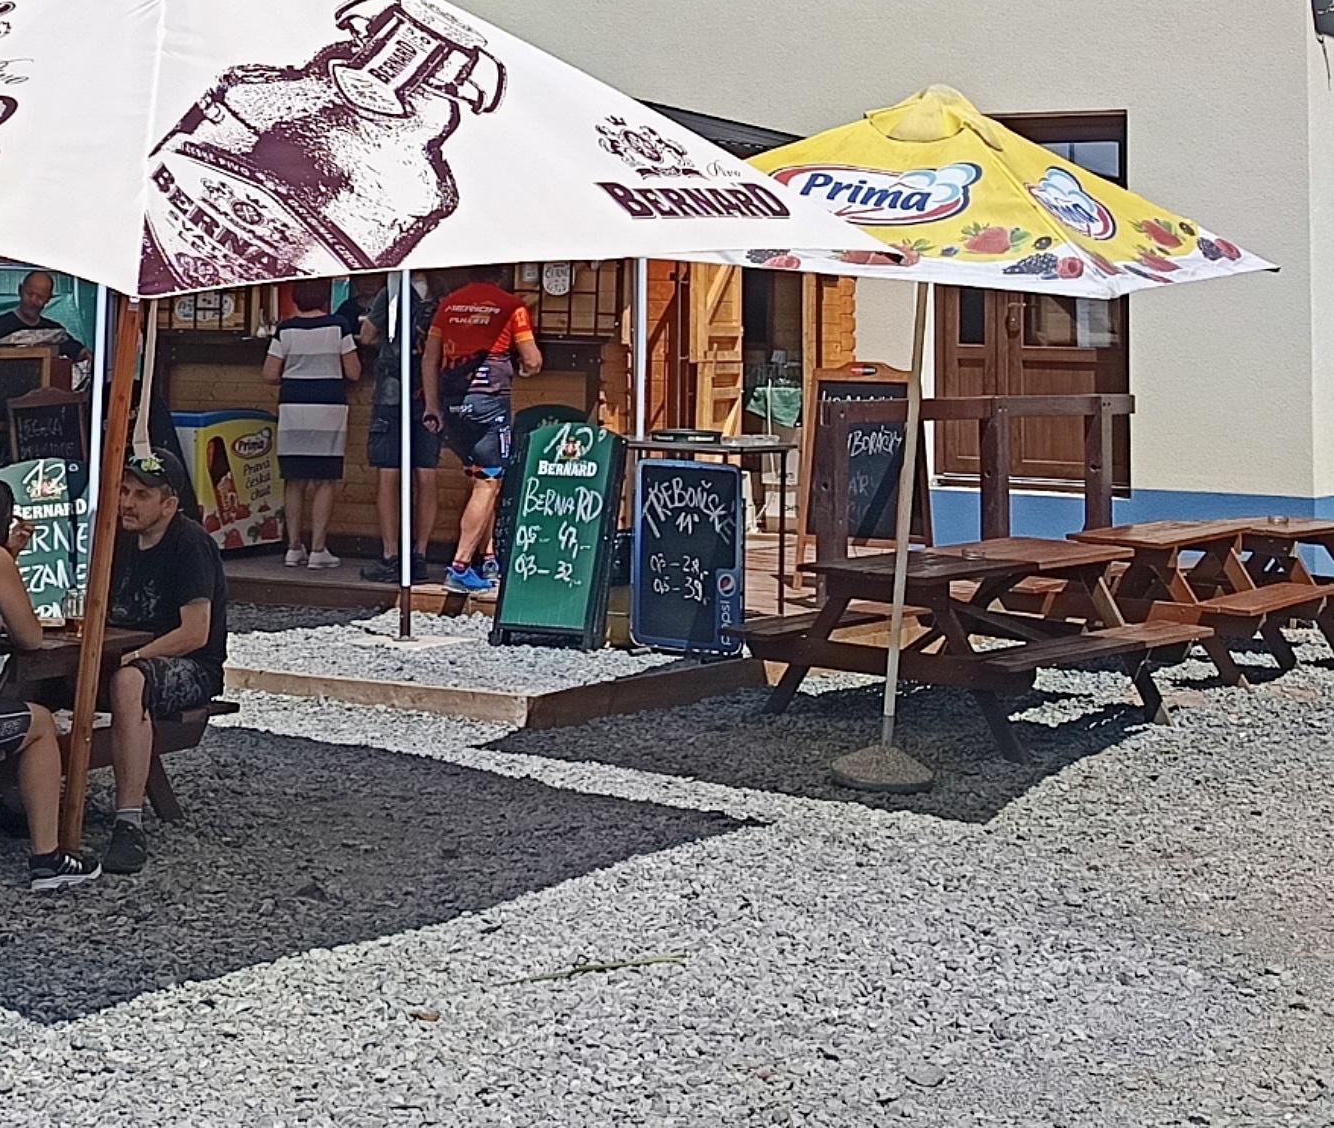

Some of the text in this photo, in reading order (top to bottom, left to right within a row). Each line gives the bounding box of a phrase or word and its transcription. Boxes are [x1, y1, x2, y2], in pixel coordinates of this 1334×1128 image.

[368, 39, 417, 85] BERNARD
[592, 182, 791, 220] BERNARD
[799, 172, 931, 213] Prima
[538, 460, 597, 477] BERNARD
[13, 498, 88, 521] BERNARD
[522, 477, 604, 523] BERNARD
[720, 600, 732, 646] ppsi
